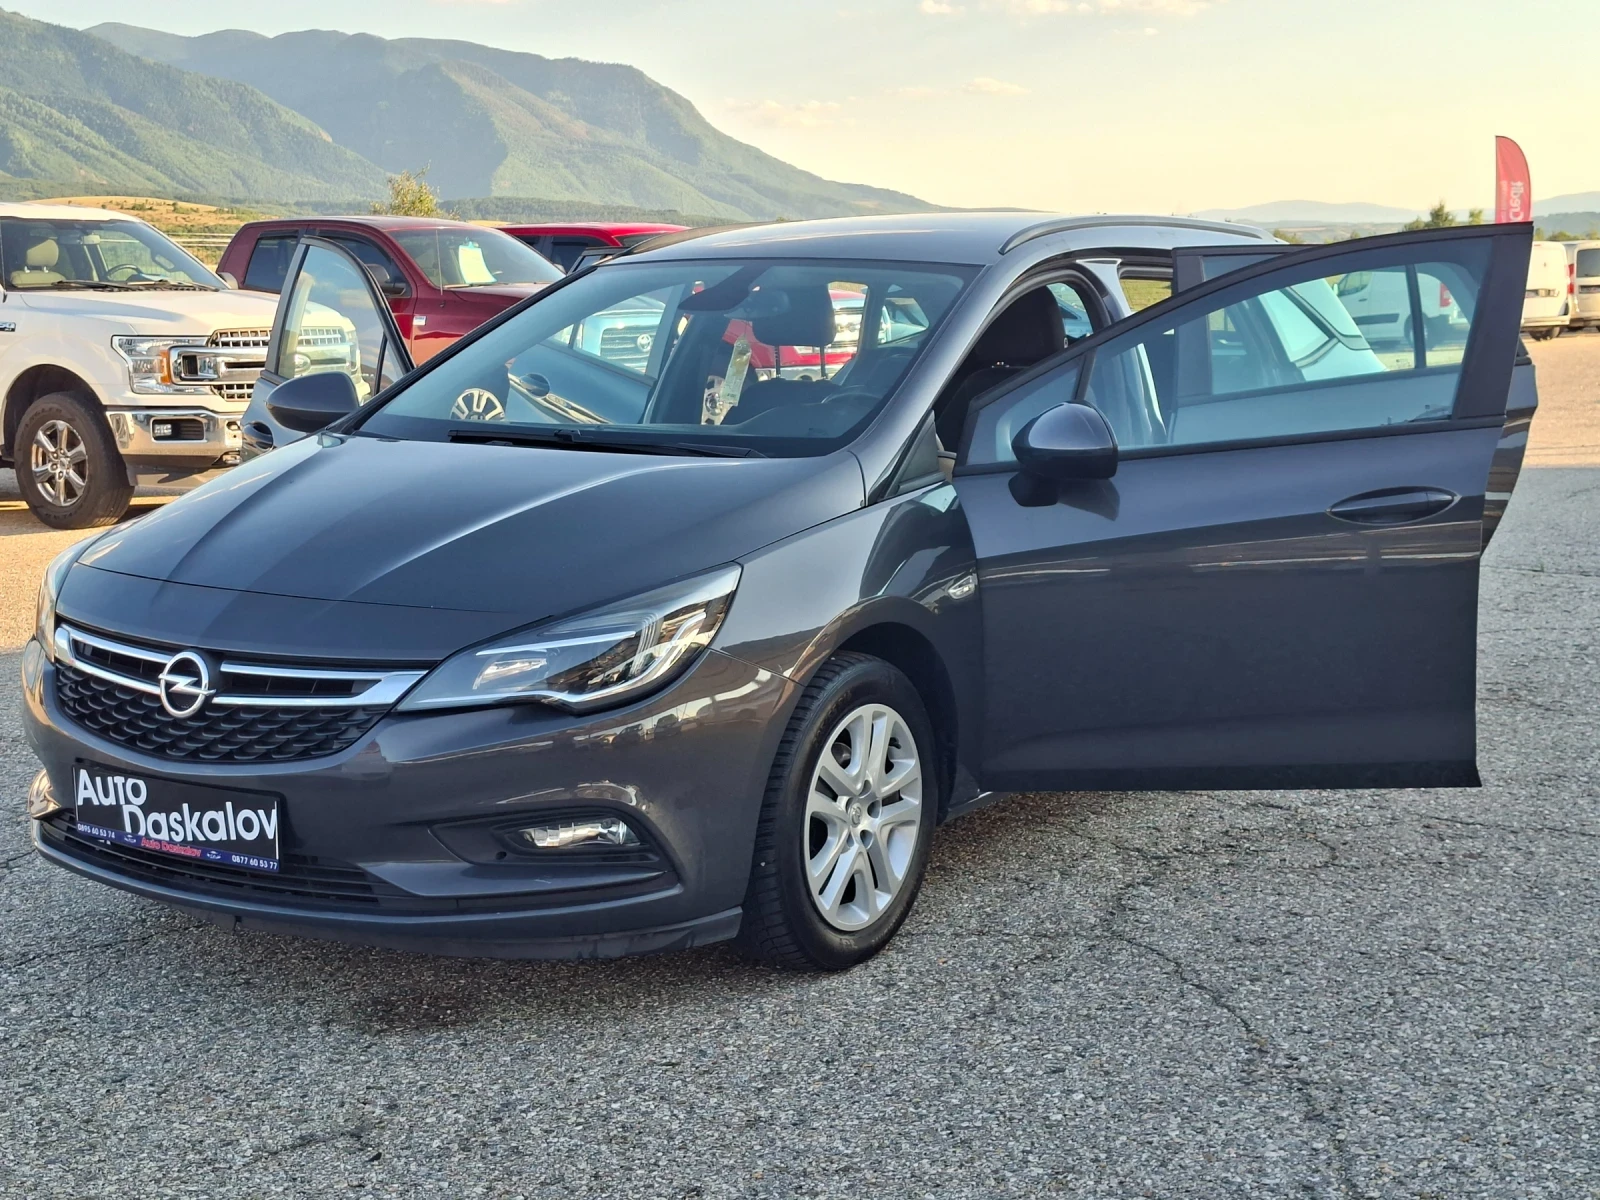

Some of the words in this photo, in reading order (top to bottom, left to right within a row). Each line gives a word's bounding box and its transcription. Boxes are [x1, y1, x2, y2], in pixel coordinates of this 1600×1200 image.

[122, 801, 277, 842] Daskalov
[77, 823, 91, 833] 0895
[92, 827, 99, 835] 60
[99, 829, 107, 837] 53
[108, 830, 115, 839] 74
[141, 837, 160, 850] Auto
[161, 841, 201, 857] Daskalov
[231, 854, 248, 865] 0877
[249, 858, 258, 867] 60
[259, 860, 268, 868] 53
[269, 861, 278, 870] 77
